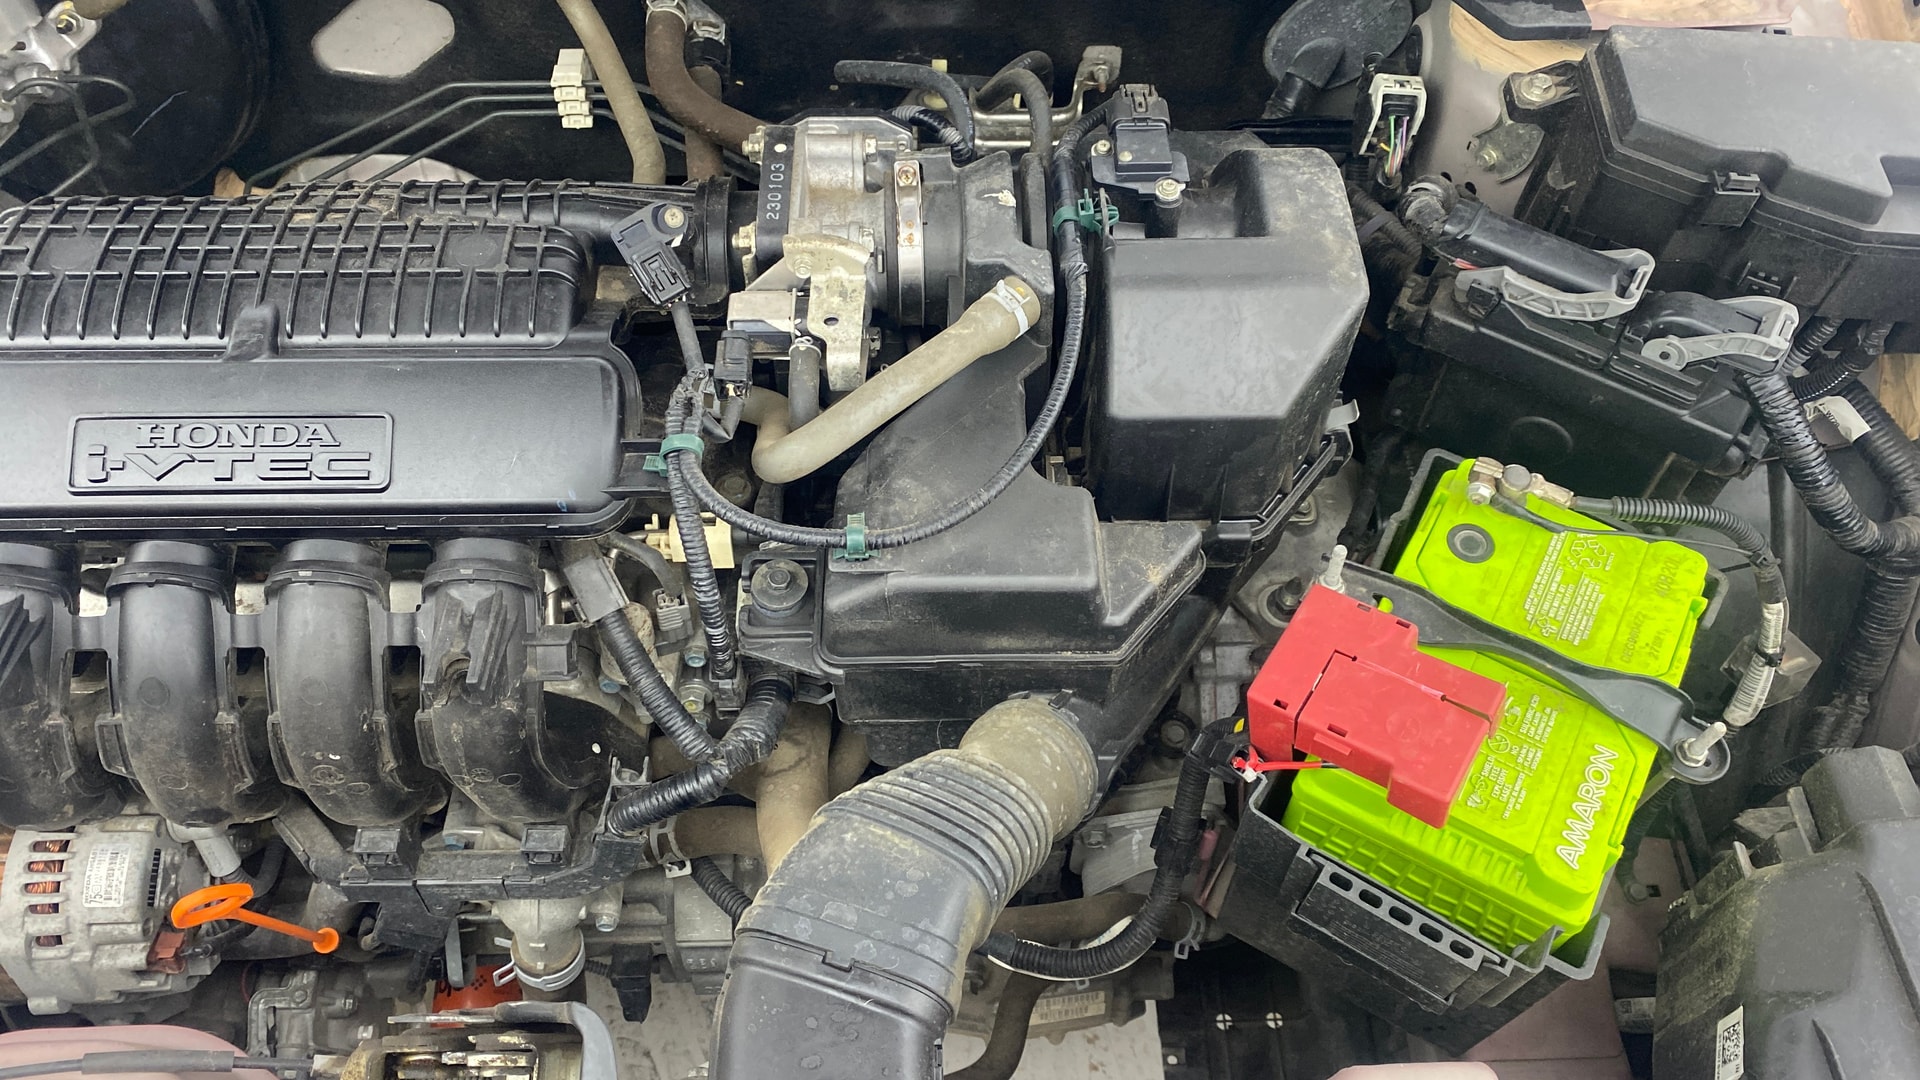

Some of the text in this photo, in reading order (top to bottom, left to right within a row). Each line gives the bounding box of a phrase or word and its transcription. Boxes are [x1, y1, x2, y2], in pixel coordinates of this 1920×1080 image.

[765, 162, 784, 220] 230103
[136, 423, 341, 449] HONDA
[87, 444, 371, 483] i-VTEC
[1510, 746, 1519, 755] NO
[1482, 755, 1495, 776] SHIELD
[1489, 766, 1500, 781] EYES
[1492, 768, 1508, 798] EXPLOSIVE
[1500, 783, 1512, 802] GASES
[1556, 743, 1619, 869] AMARON
